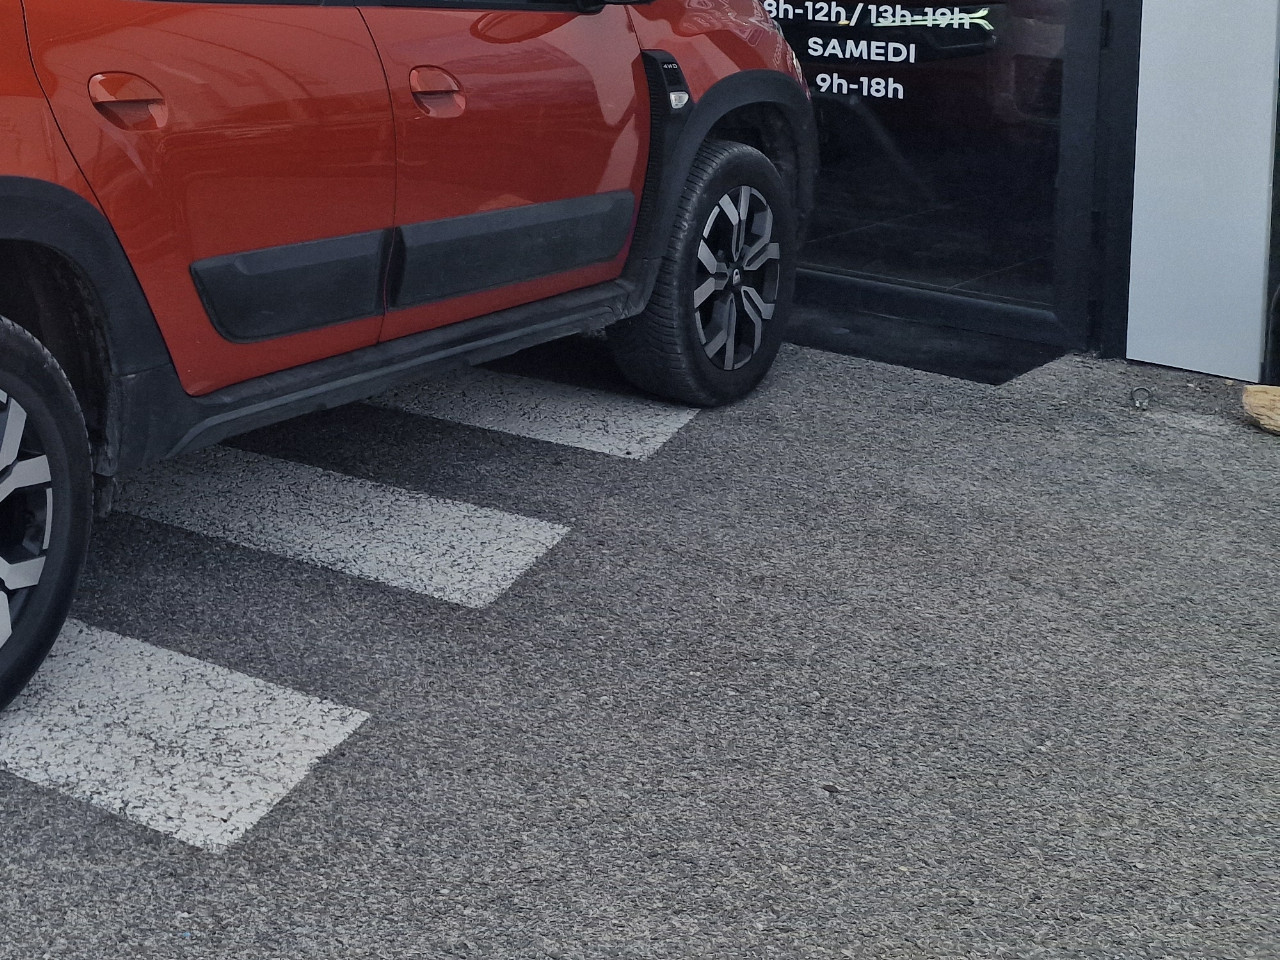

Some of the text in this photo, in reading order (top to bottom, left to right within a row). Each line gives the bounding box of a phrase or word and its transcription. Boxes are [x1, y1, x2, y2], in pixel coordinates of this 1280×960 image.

[763, 0, 847, 23] 8h-12h
[868, 4, 971, 30] 13h-19h
[807, 37, 917, 63] SAMEDI
[816, 73, 904, 100] 9h-18h
